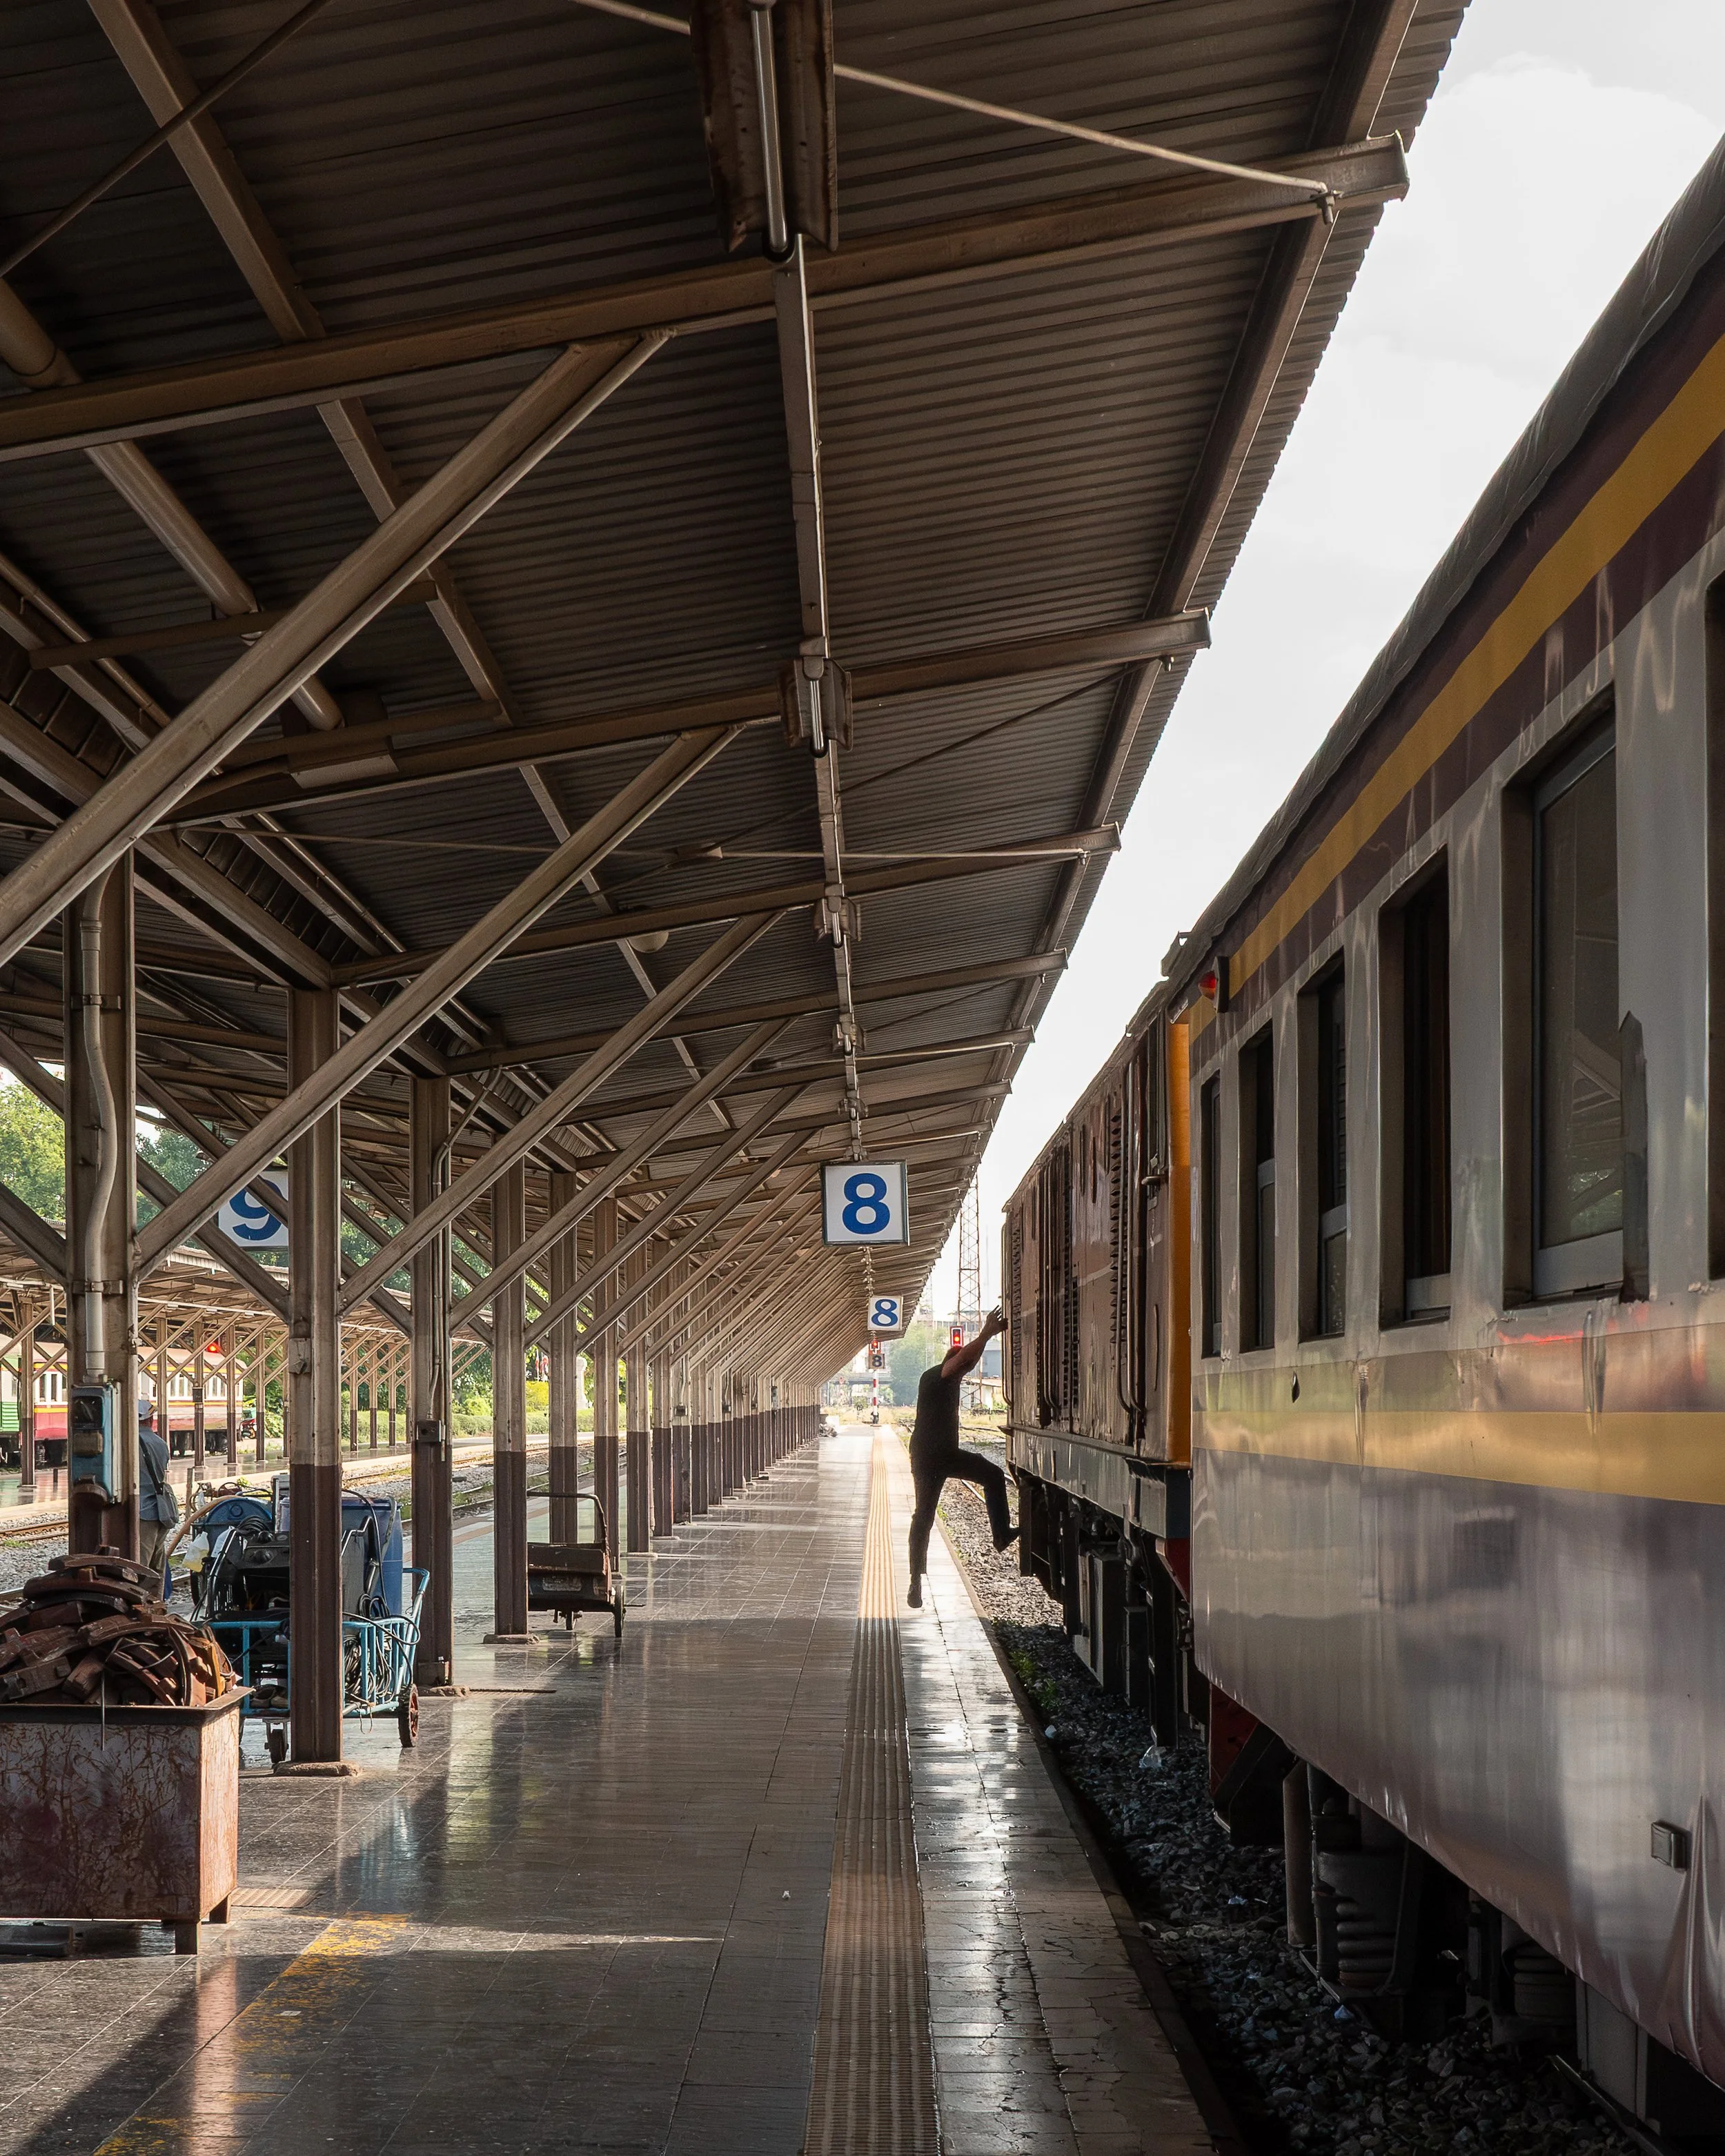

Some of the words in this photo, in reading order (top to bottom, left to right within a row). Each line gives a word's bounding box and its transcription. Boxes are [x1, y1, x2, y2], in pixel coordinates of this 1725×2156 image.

[229, 1179, 284, 1240] 9
[842, 1172, 891, 1235] 8
[871, 1298, 898, 1326] 8
[872, 1355, 882, 1367] 8
